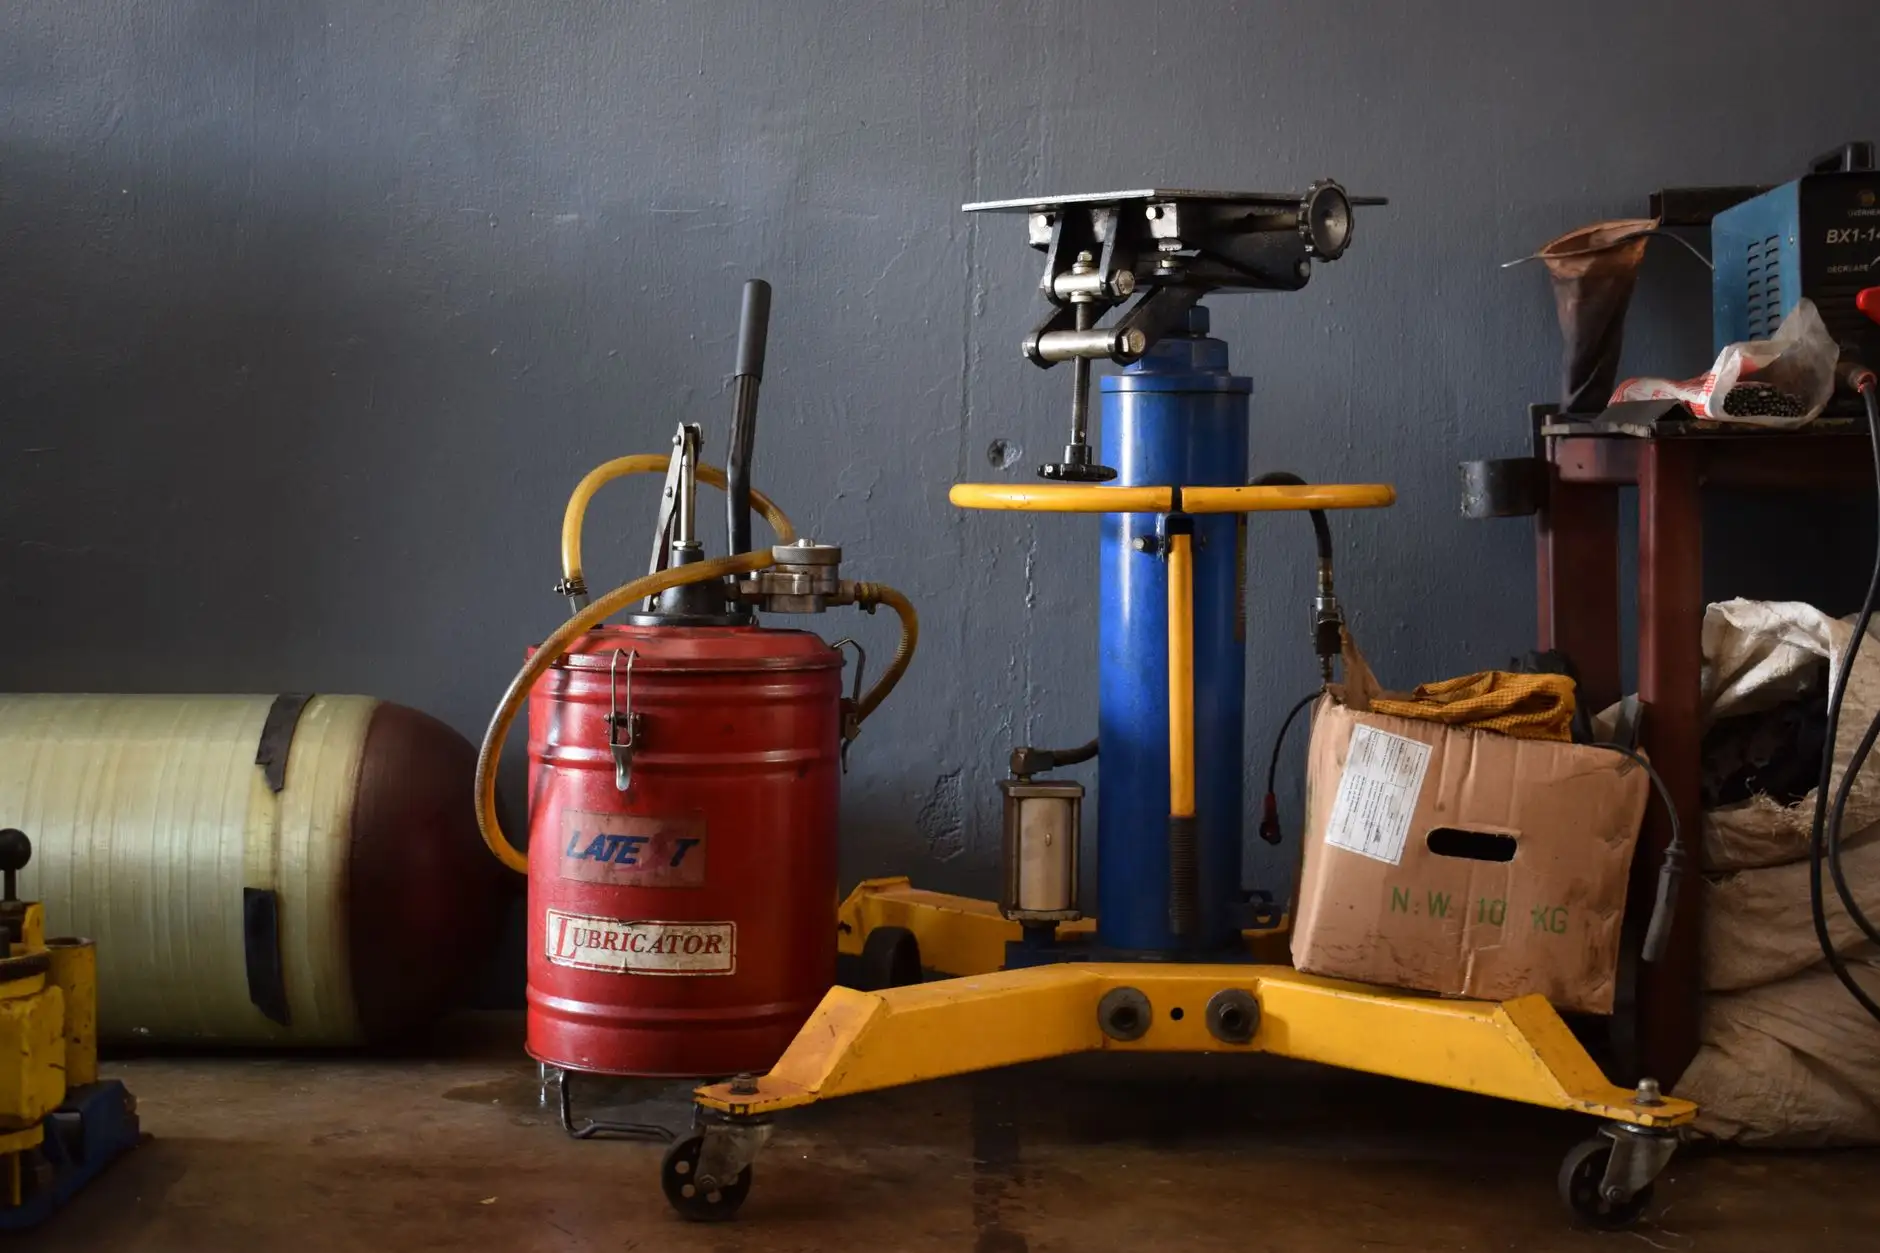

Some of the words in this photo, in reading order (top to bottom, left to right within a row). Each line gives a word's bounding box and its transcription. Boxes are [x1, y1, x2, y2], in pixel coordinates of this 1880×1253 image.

[1477, 897, 1507, 927] 10
[1530, 903, 1569, 934] KG
[554, 917, 723, 959] LUBRICATOR
